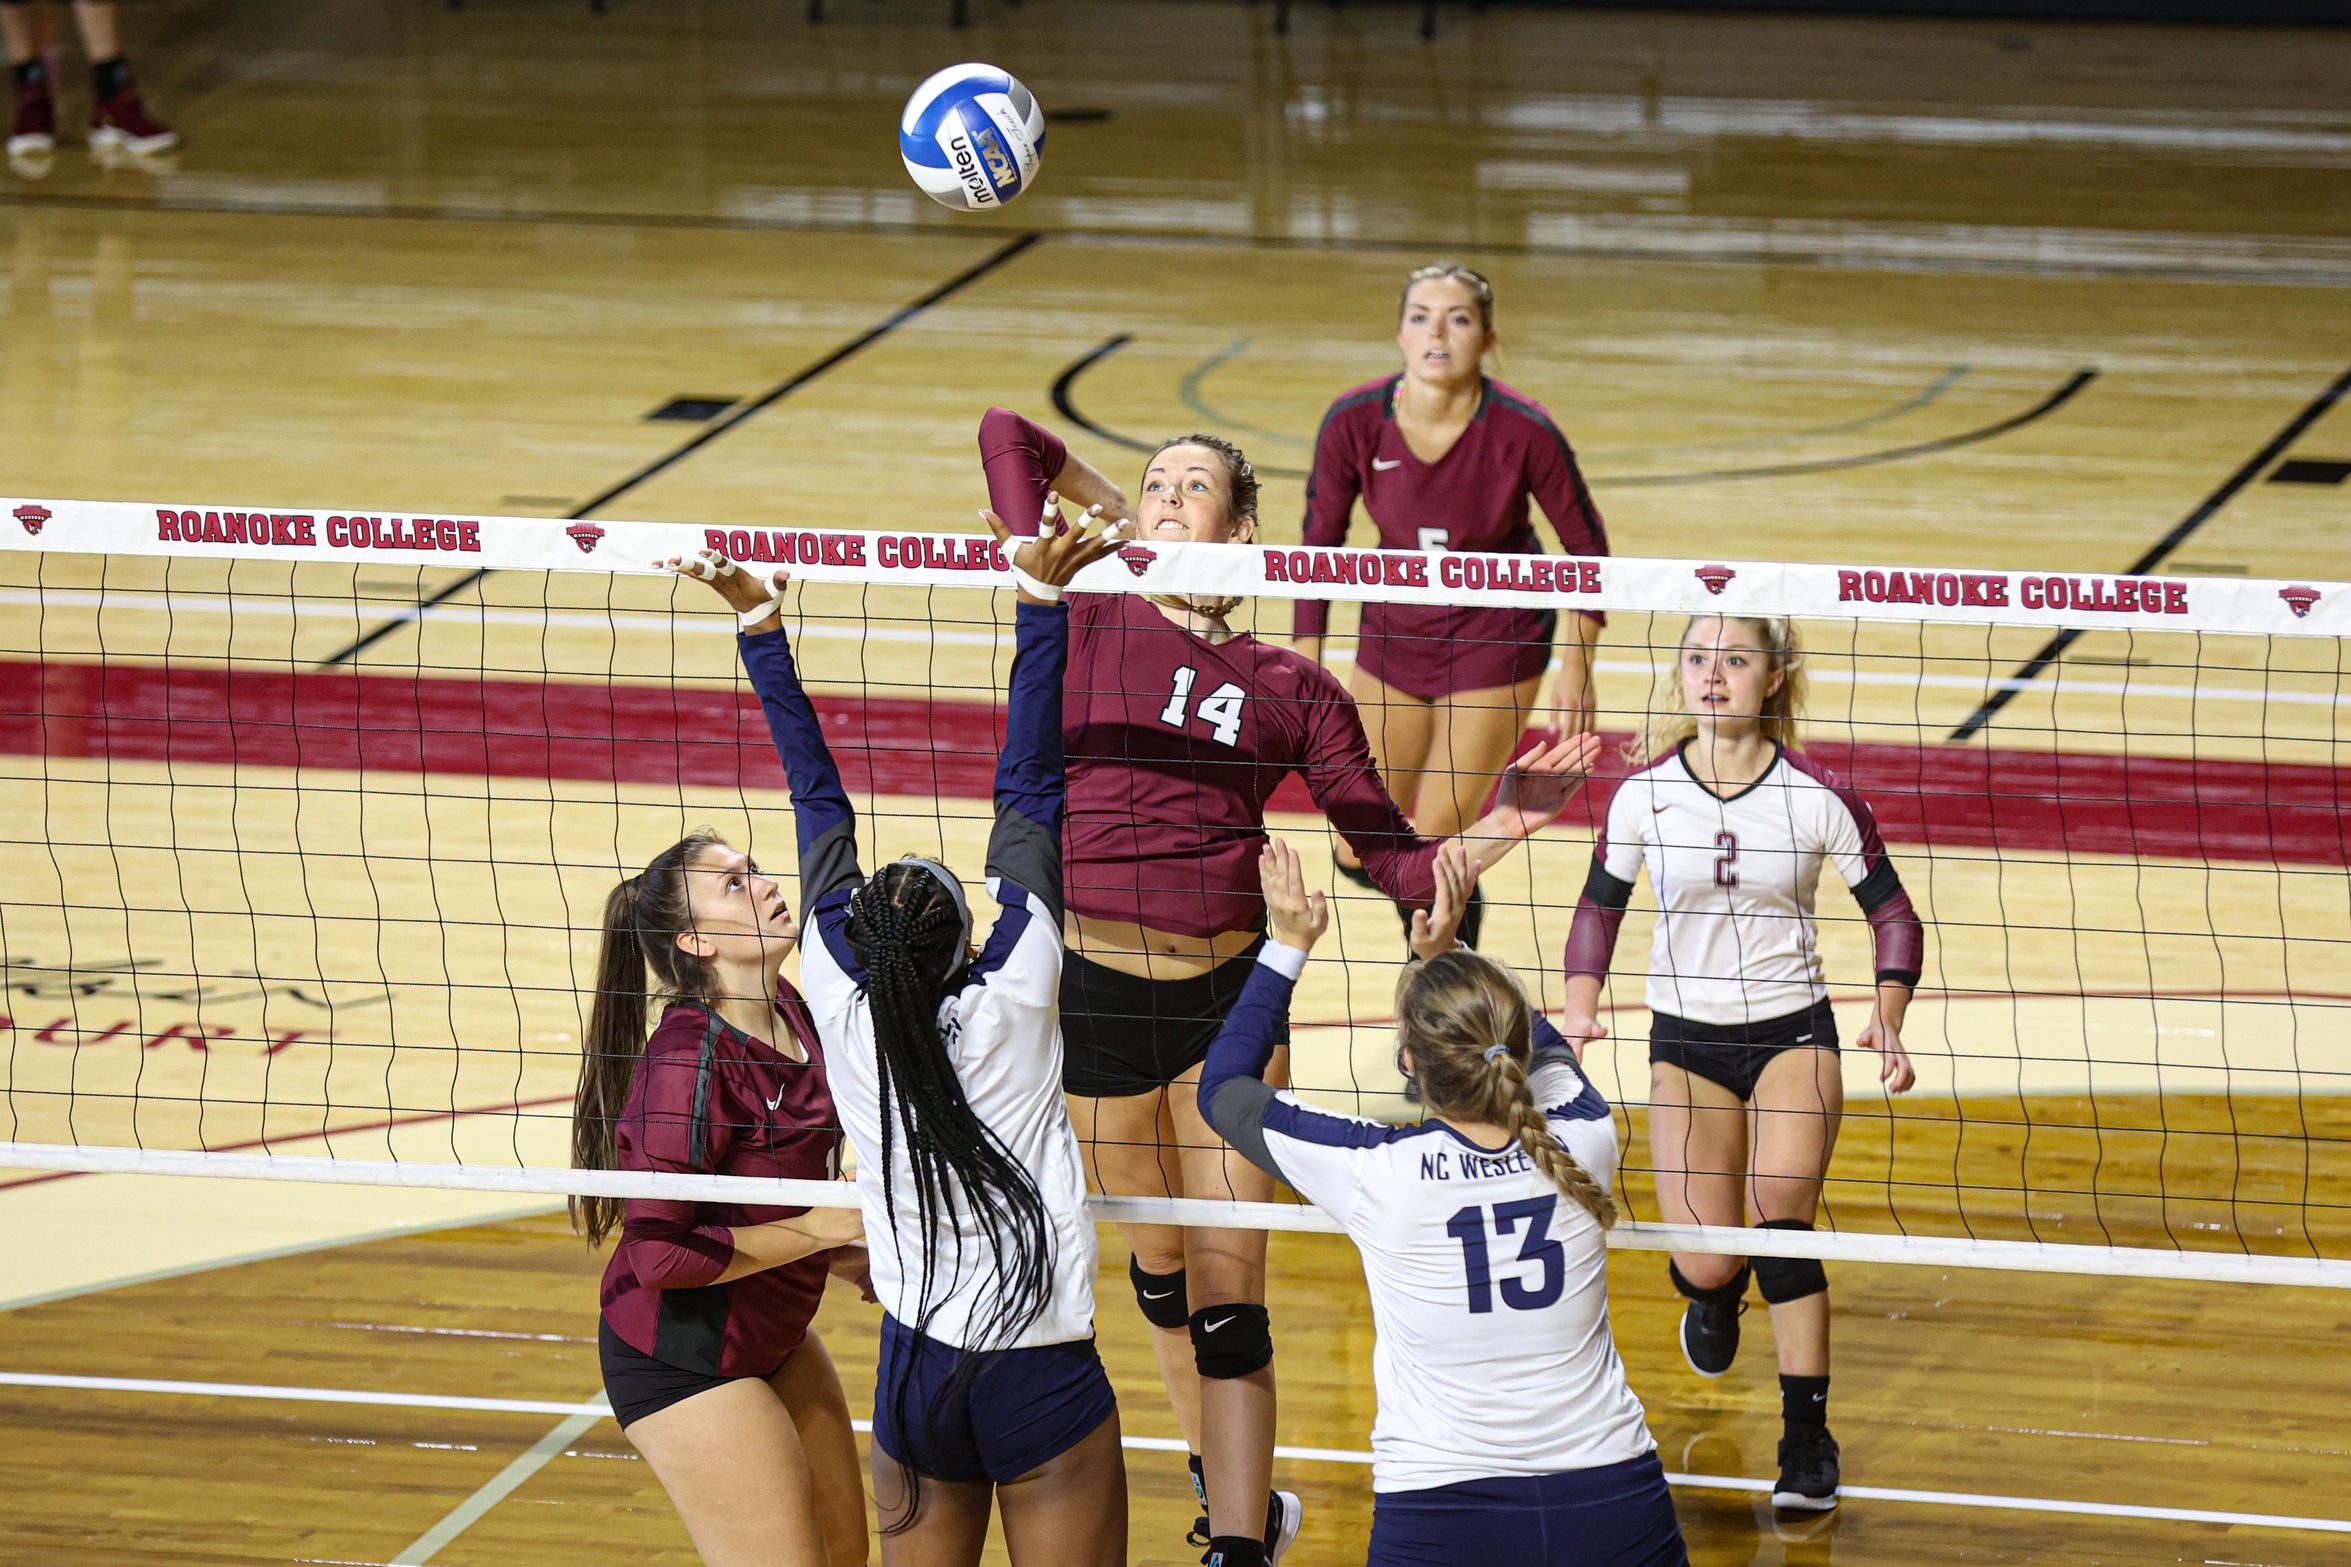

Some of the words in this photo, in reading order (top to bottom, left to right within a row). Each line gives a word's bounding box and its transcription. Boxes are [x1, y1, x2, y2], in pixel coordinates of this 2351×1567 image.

[950, 136, 994, 203] molten
[976, 126, 1017, 188] NCAA
[156, 509, 316, 546] ROANOKE
[326, 516, 481, 552] COLLEGE
[704, 529, 866, 567] ROANOKE
[877, 536, 1012, 572] COLLEG
[1263, 550, 1429, 588] ROANOKE
[1440, 557, 1603, 593] COLLEGE
[1838, 570, 2010, 607] ROANOKE
[2021, 576, 2189, 614] COLLEGE
[1159, 664, 1247, 748] 14
[1713, 830, 1740, 889] 2
[0, 1015, 341, 1057] URT
[1420, 1152, 1450, 1181] NC
[1458, 1149, 1535, 1180] WESLE
[1446, 1193, 1566, 1314] 13
